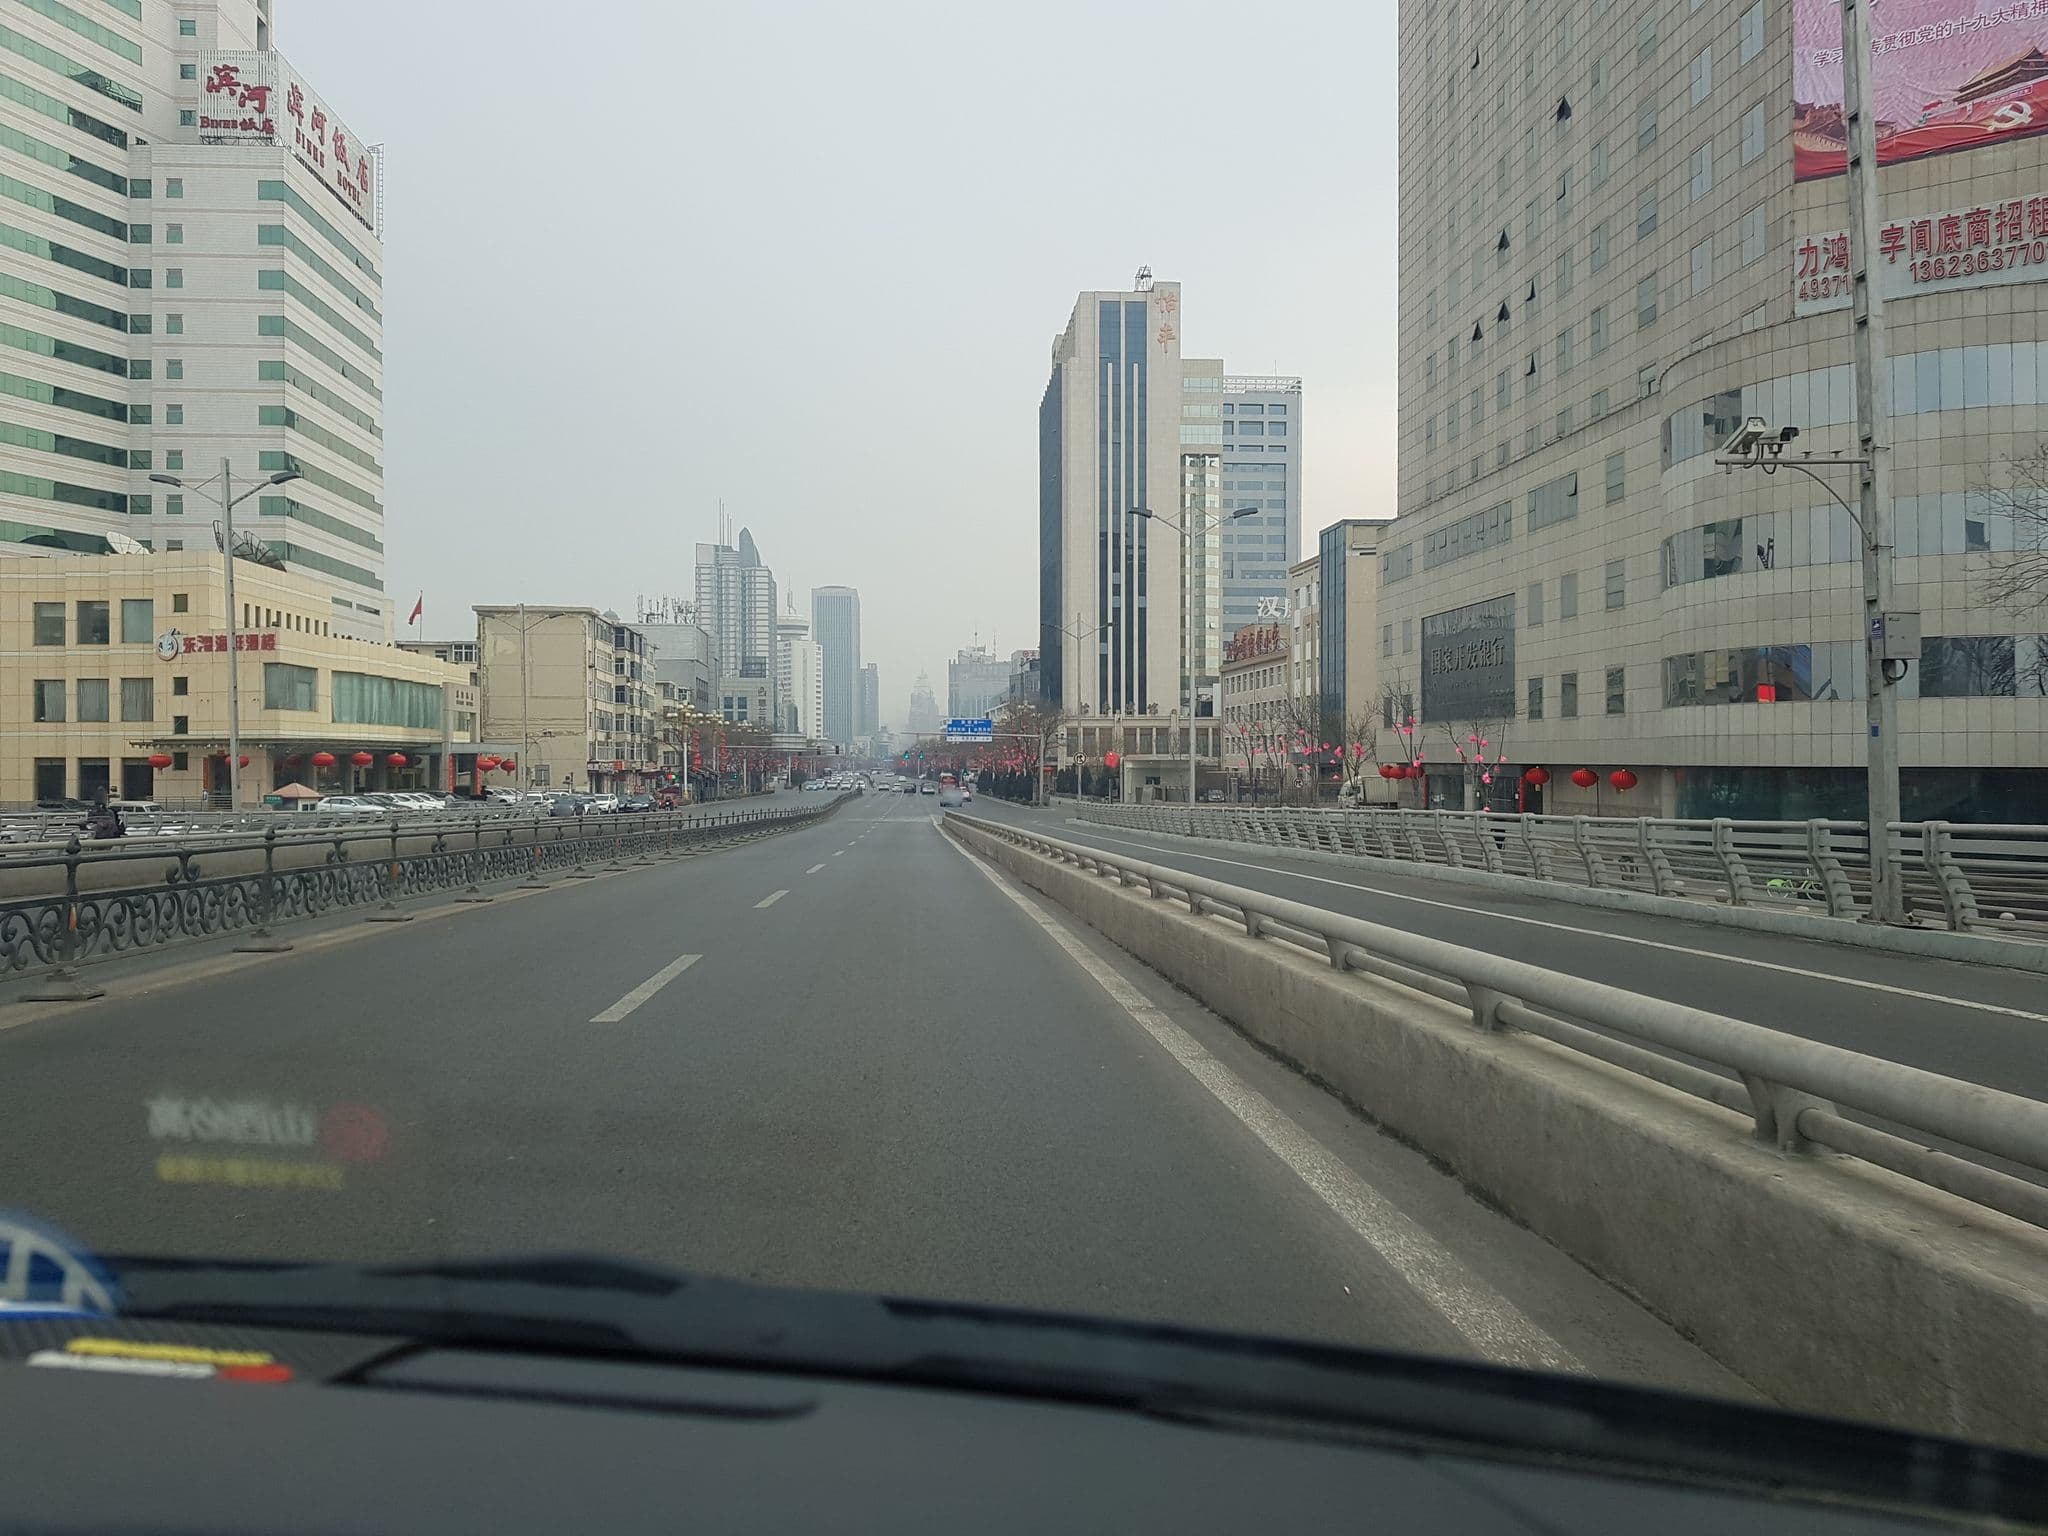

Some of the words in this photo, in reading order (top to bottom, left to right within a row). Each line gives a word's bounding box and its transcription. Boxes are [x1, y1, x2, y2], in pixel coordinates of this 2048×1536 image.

[206, 63, 272, 113] 滨河
[295, 126, 325, 169] BINHE
[336, 168, 361, 206] HOTEL
[1909, 240, 2048, 284] 1362363770
[1431, 635, 1504, 676] 国家开发银行
